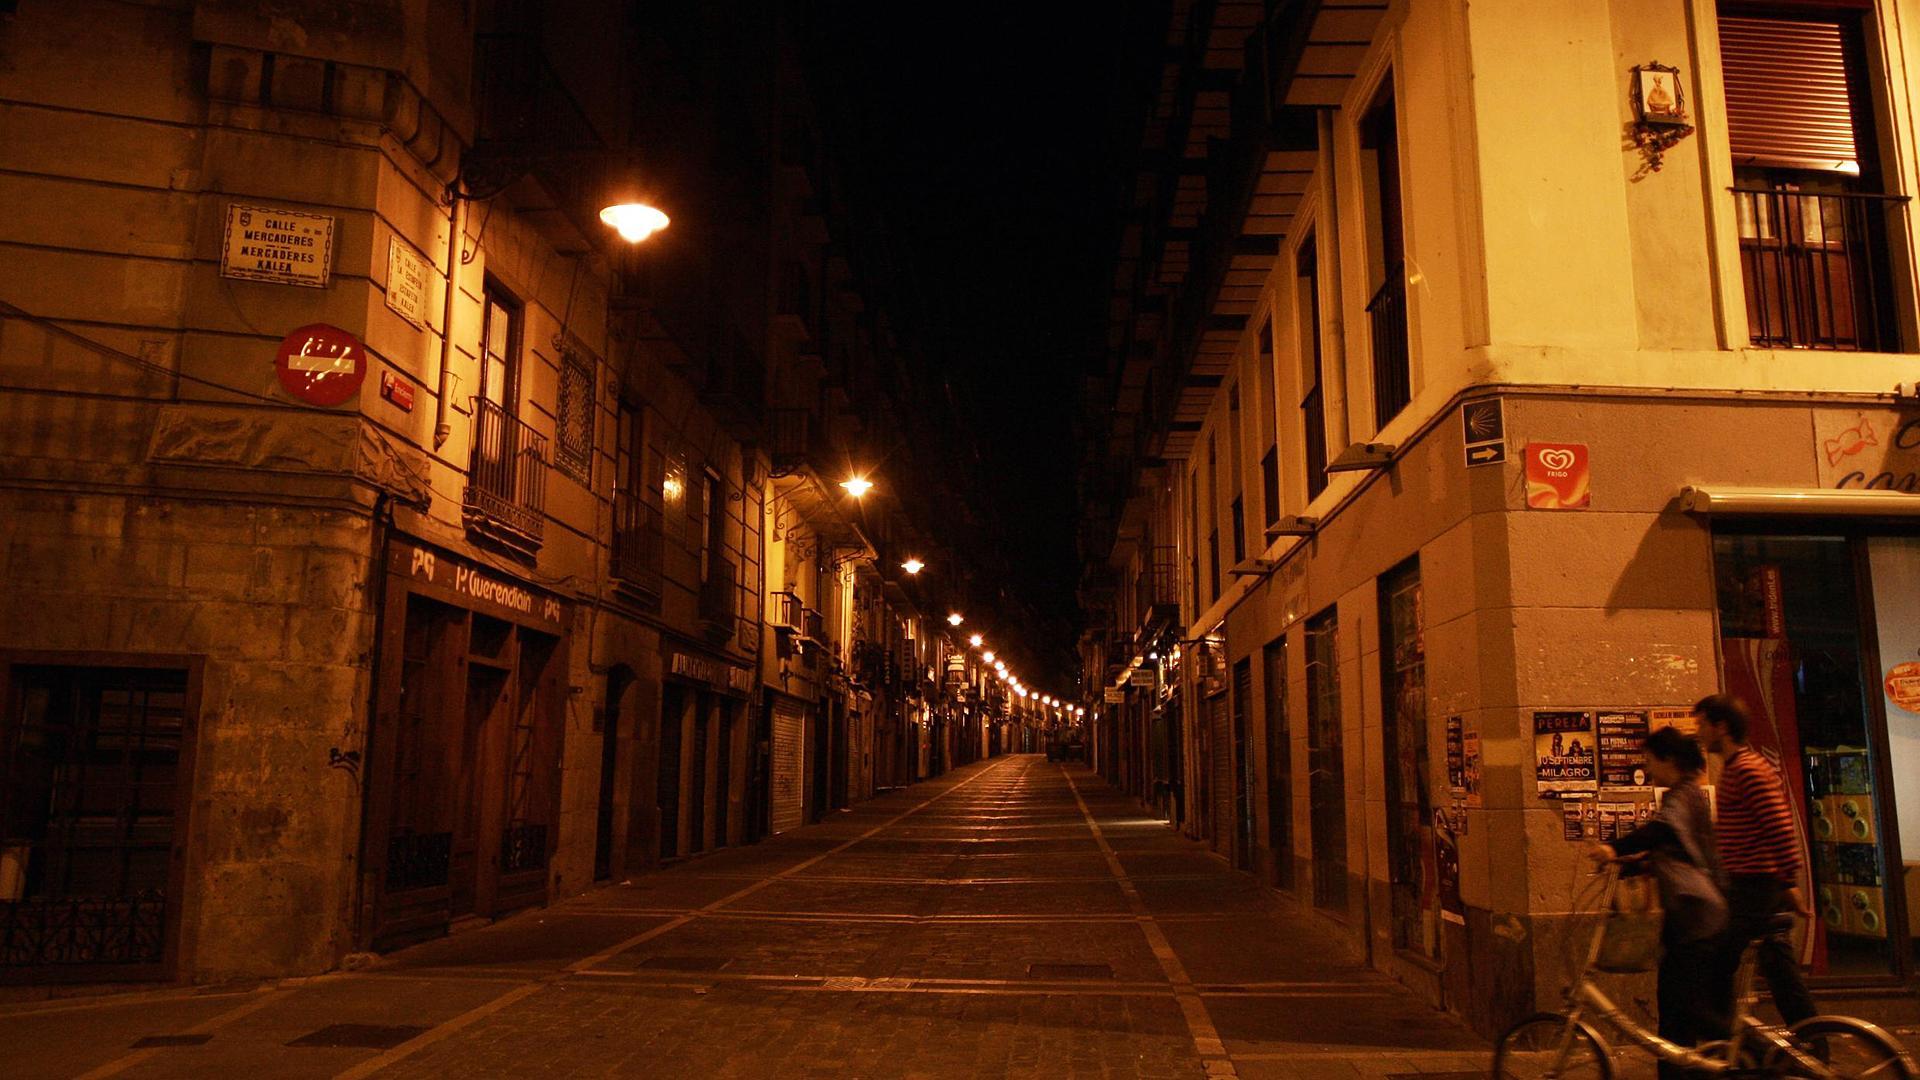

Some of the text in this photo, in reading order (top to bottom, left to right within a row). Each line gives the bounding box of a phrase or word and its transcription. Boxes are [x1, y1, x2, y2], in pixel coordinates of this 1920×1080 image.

[265, 219, 296, 231] CALLE
[245, 230, 314, 247] MERCADERES
[241, 246, 315, 263] MERCADERES
[257, 260, 292, 273] KALEA
[469, 570, 532, 614] Guerendiain
[1538, 717, 1588, 729] PEREZA
[1549, 756, 1593, 765] SEPTIEMBRE
[1542, 768, 1590, 777] MILAGRO
